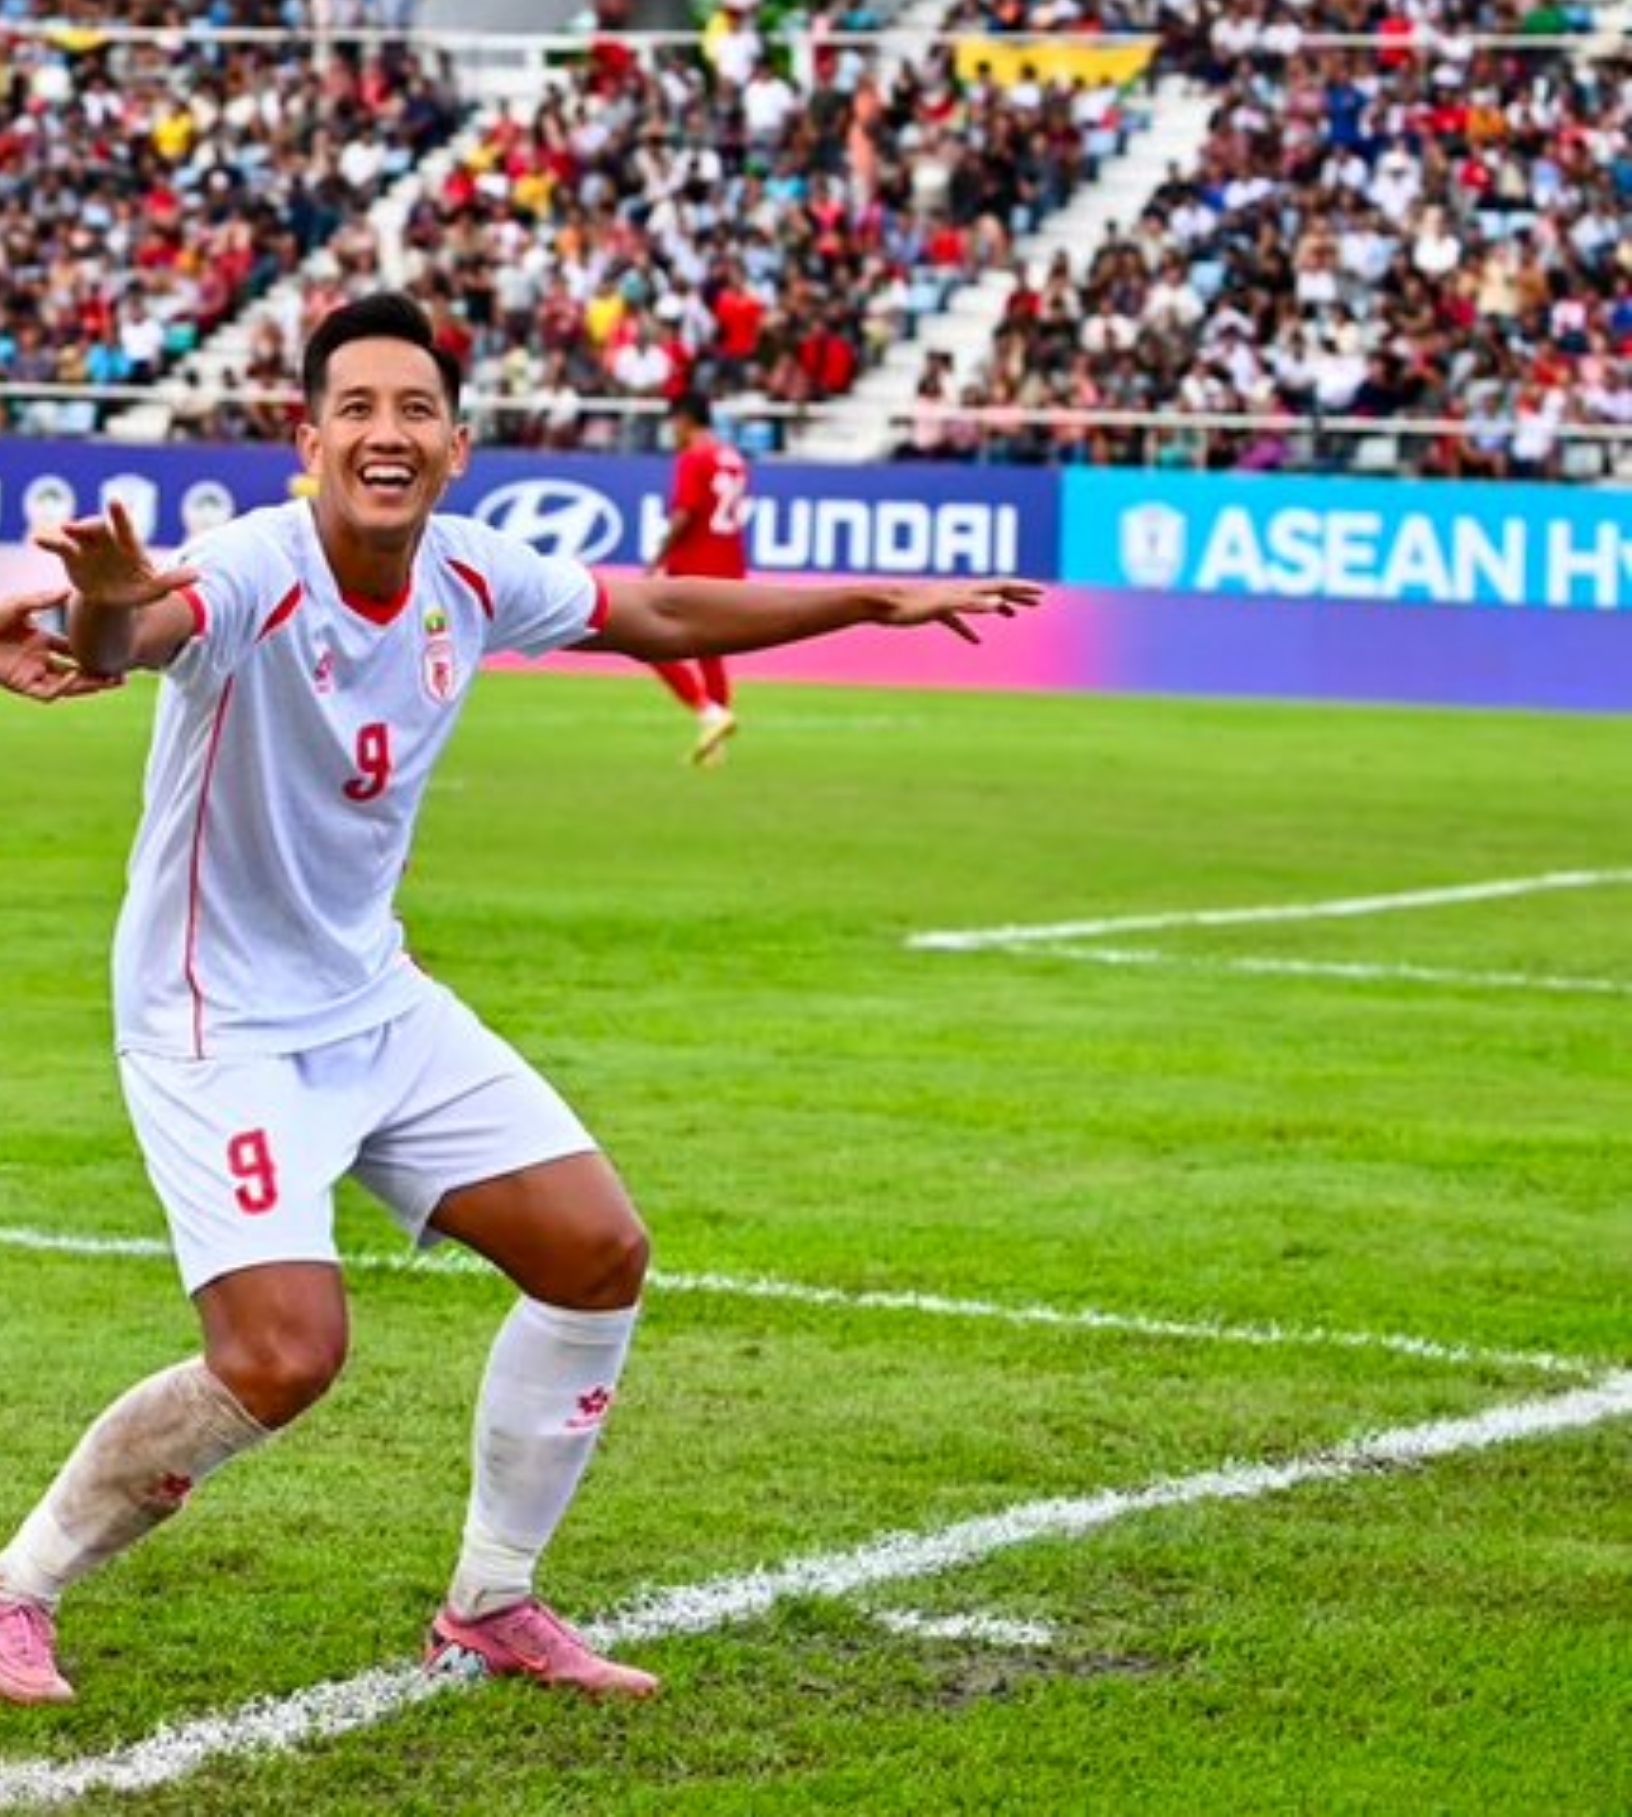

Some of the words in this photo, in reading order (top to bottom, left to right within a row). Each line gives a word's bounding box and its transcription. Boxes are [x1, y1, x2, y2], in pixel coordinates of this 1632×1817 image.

[641, 492, 1019, 575] HUNDAI
[1193, 505, 1527, 607] ASEAN
[342, 721, 393, 803] 9
[226, 1127, 279, 1216] 9
